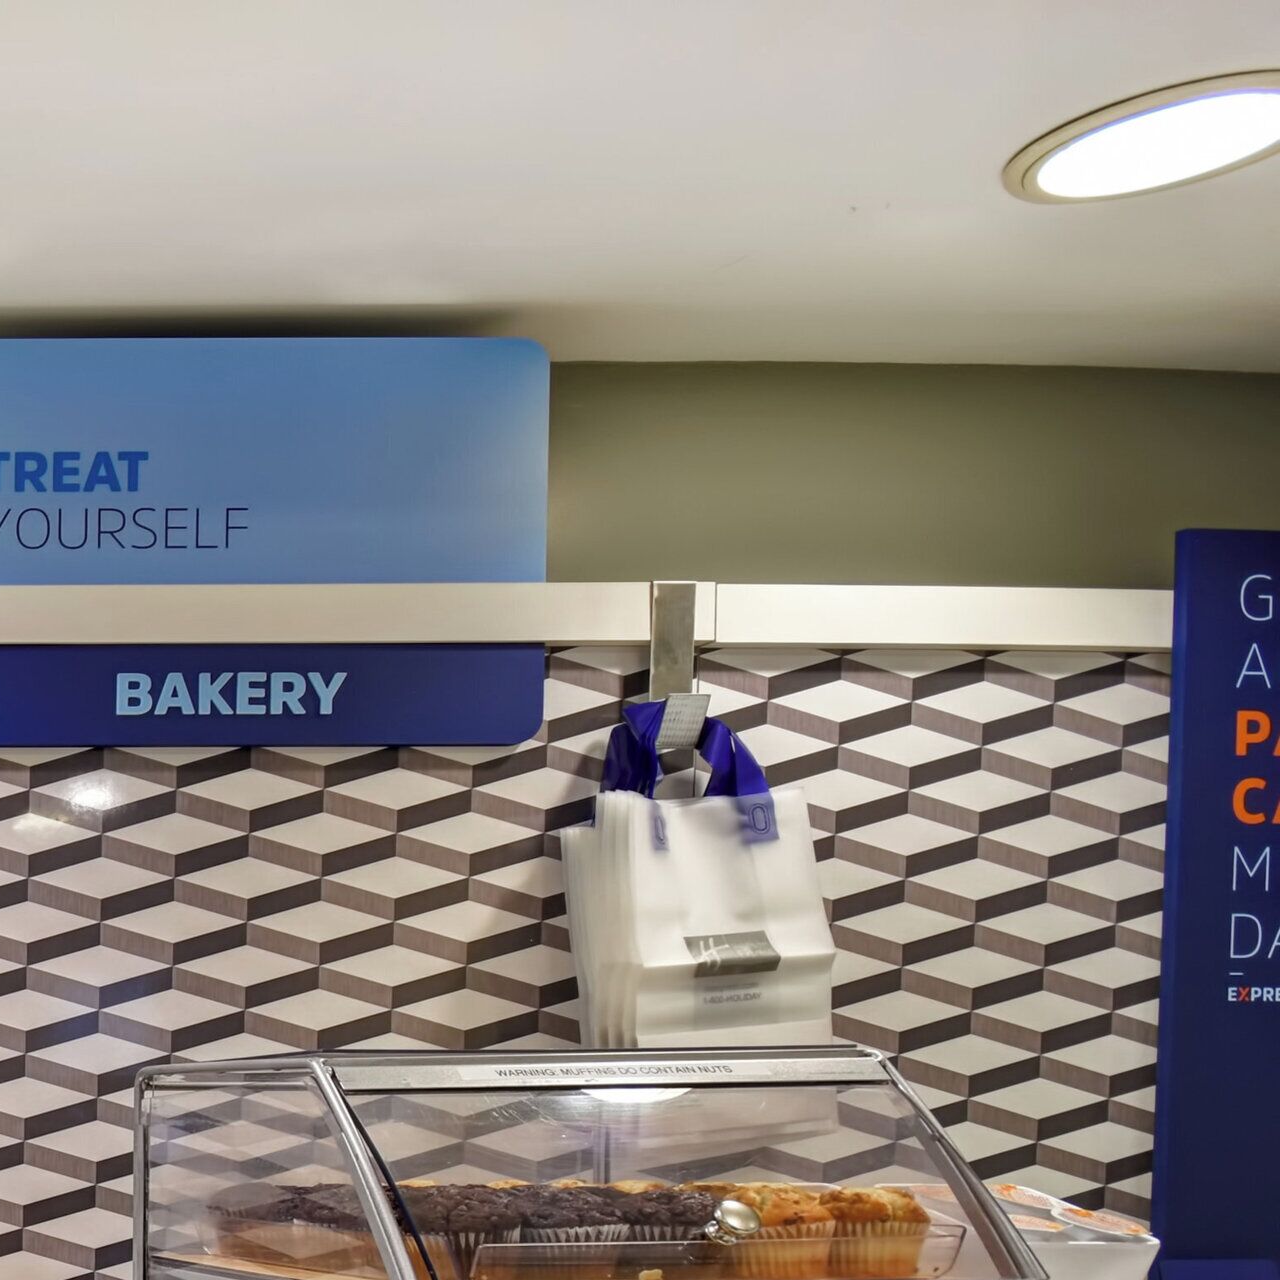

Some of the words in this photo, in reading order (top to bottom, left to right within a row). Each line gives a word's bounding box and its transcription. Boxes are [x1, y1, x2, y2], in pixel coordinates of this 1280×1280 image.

[115, 671, 348, 717] BAKERY
[1235, 710, 1280, 757] P
[1232, 777, 1280, 825] C
[496, 1068, 556, 1077] WARNING:
[560, 1067, 616, 1076] MUFFINS
[618, 1067, 638, 1075] DO
[640, 1066, 696, 1075] CONTAIN
[698, 1065, 733, 1074] NUTS
